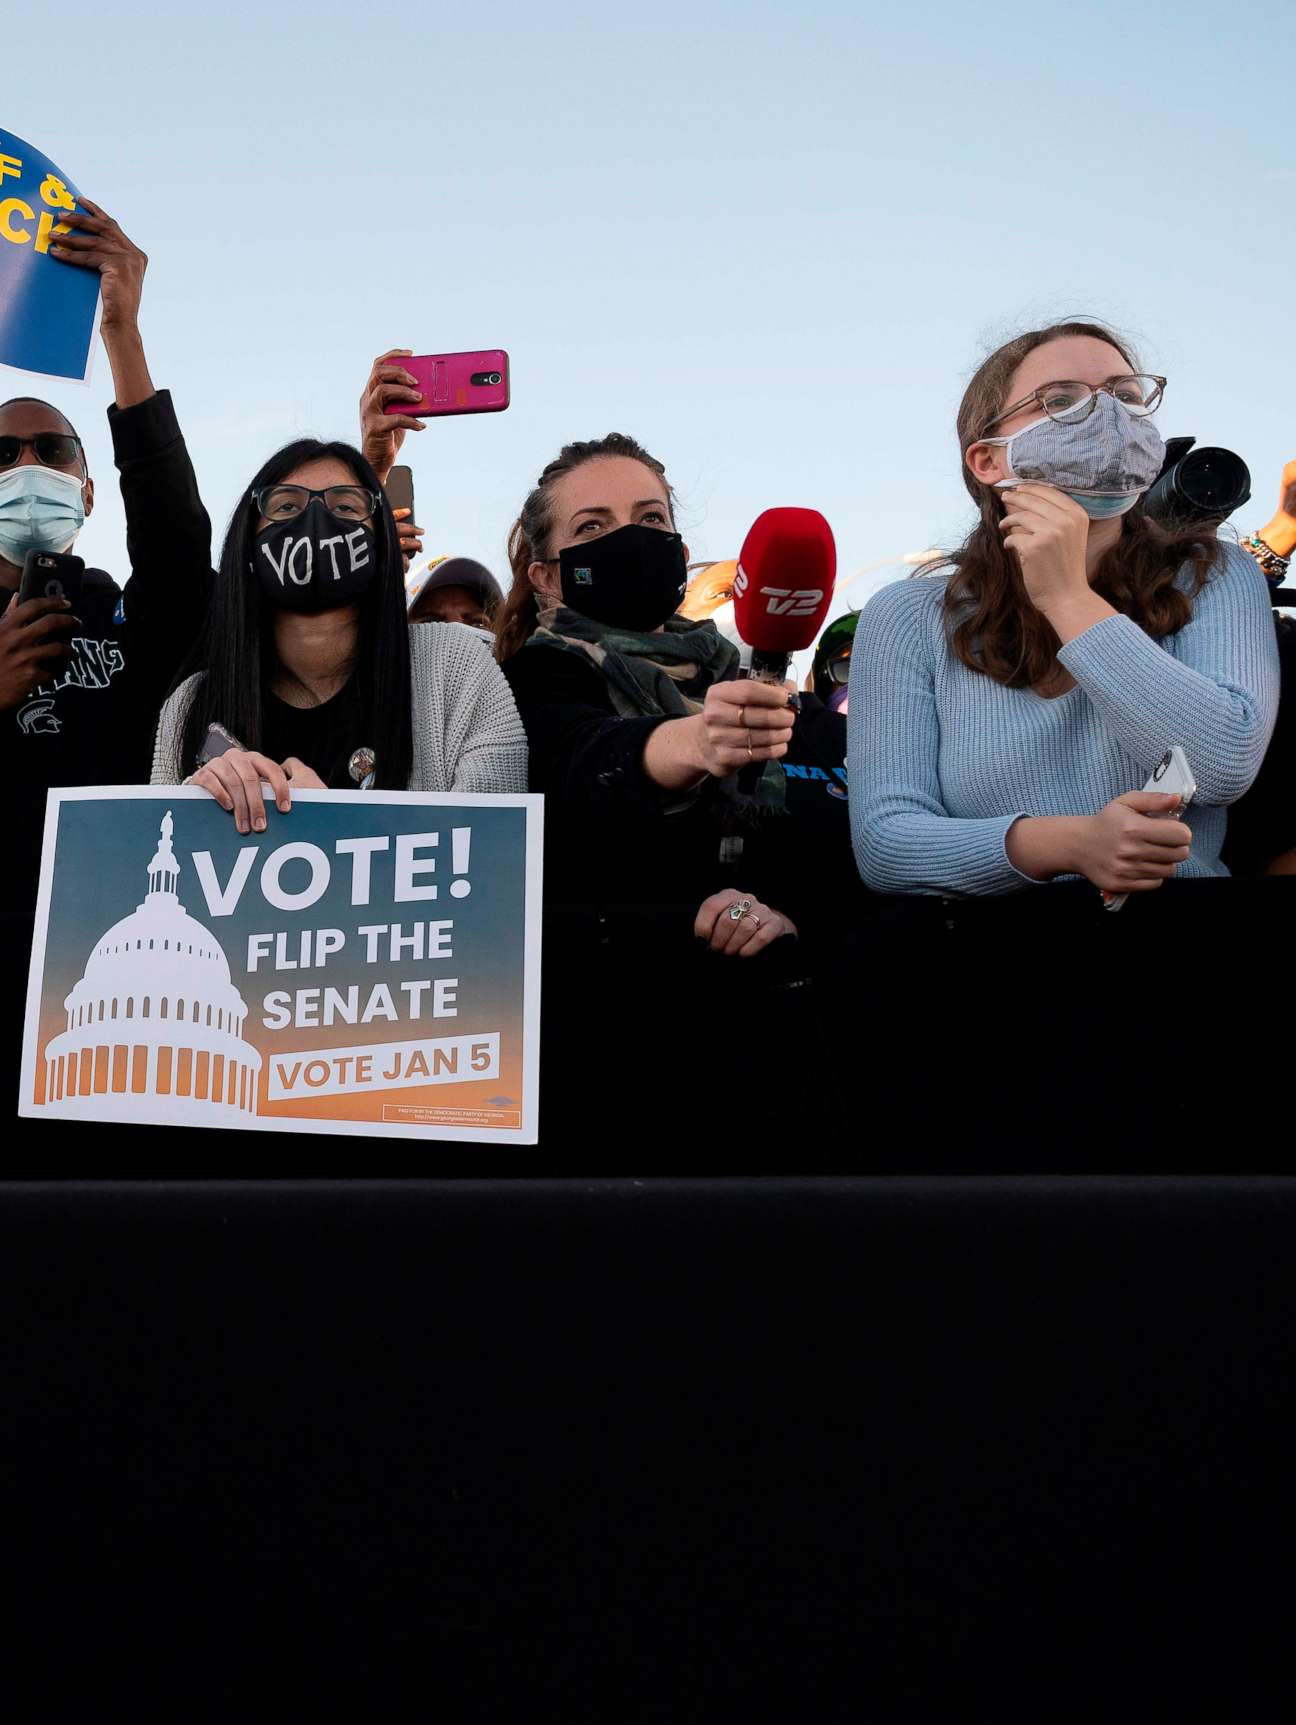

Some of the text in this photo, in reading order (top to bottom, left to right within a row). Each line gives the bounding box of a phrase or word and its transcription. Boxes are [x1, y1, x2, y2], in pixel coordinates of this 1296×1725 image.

[39, 173, 77, 211] &
[261, 527, 370, 586] VOTE
[191, 826, 472, 917] VOTE!
[247, 919, 454, 973] FLIP THE
[262, 978, 459, 1030] SENATE
[277, 1042, 491, 1090] VOTE JAN 5
